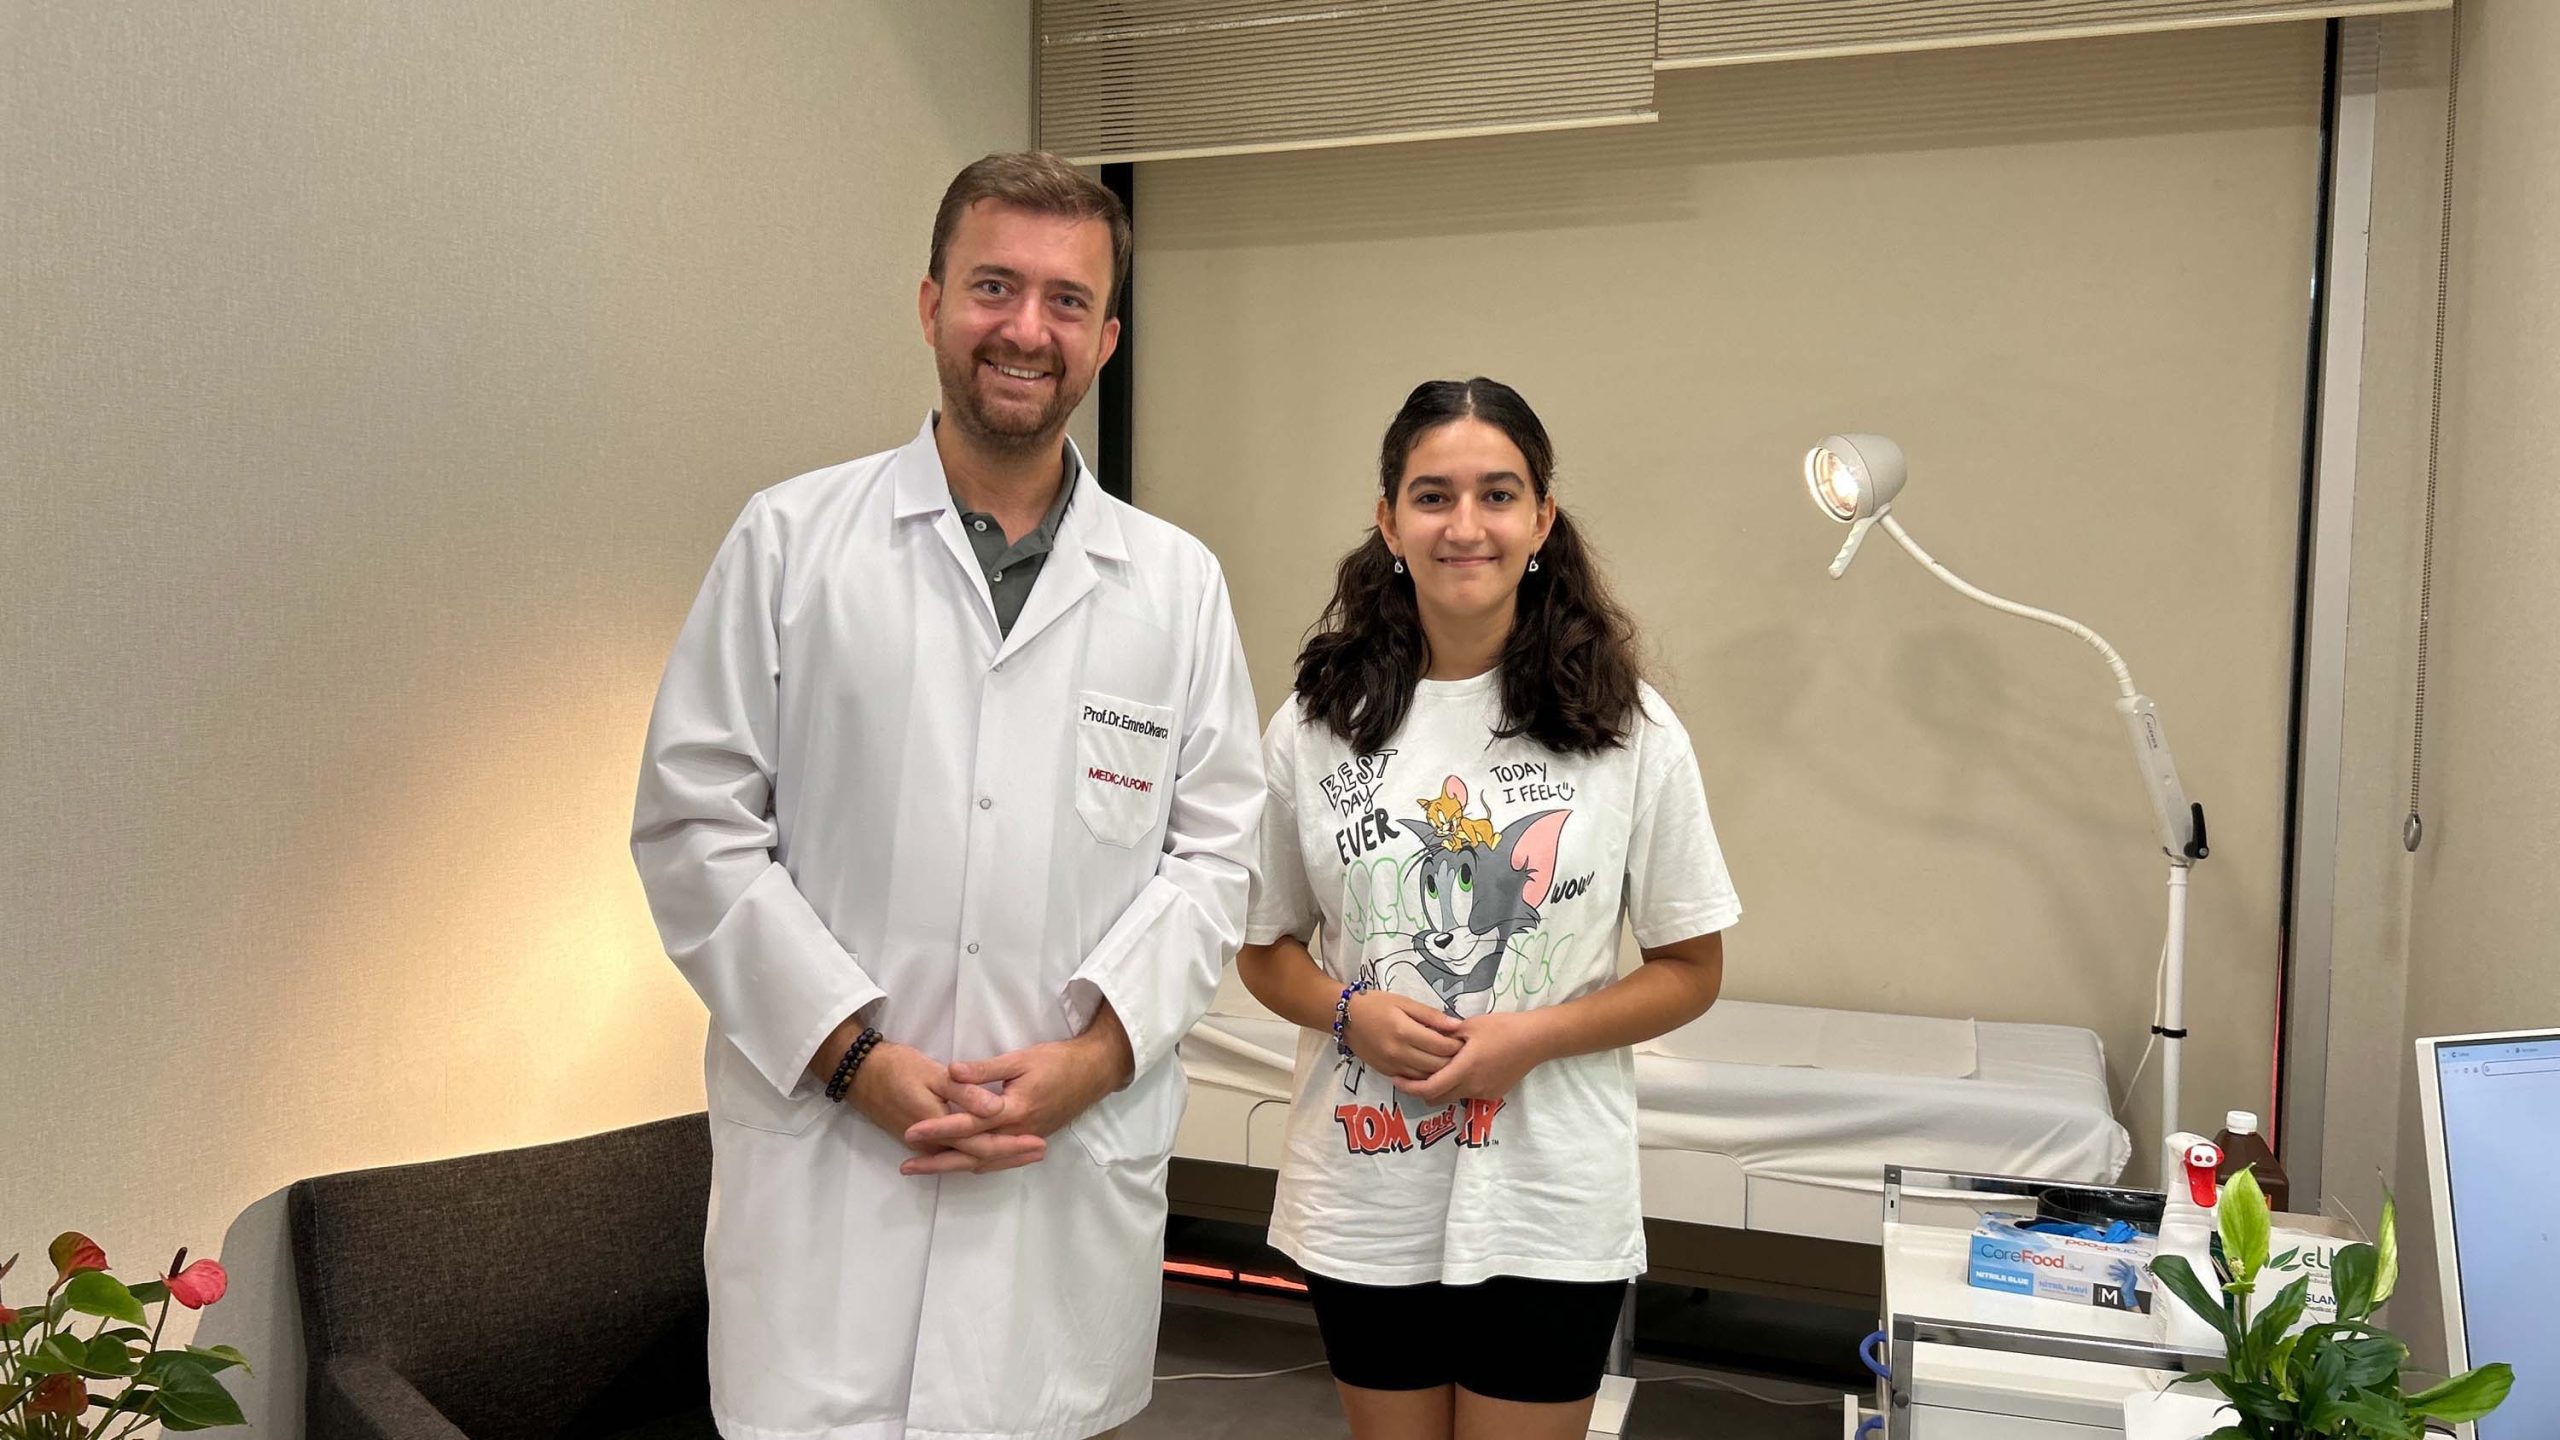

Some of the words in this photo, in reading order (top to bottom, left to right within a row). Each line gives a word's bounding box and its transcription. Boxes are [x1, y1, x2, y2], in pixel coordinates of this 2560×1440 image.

[1319, 749, 1398, 810] BEST
[1489, 762, 1548, 783] TODAY
[1341, 783, 1384, 818] DAY
[1503, 788, 1514, 804] I
[1520, 785, 1558, 803] FEEL
[1336, 808, 1401, 866] EVER
[1334, 1103, 1414, 1154] TOM
[1981, 1243, 2065, 1269] CareFood
[2101, 1287, 2118, 1305] M
